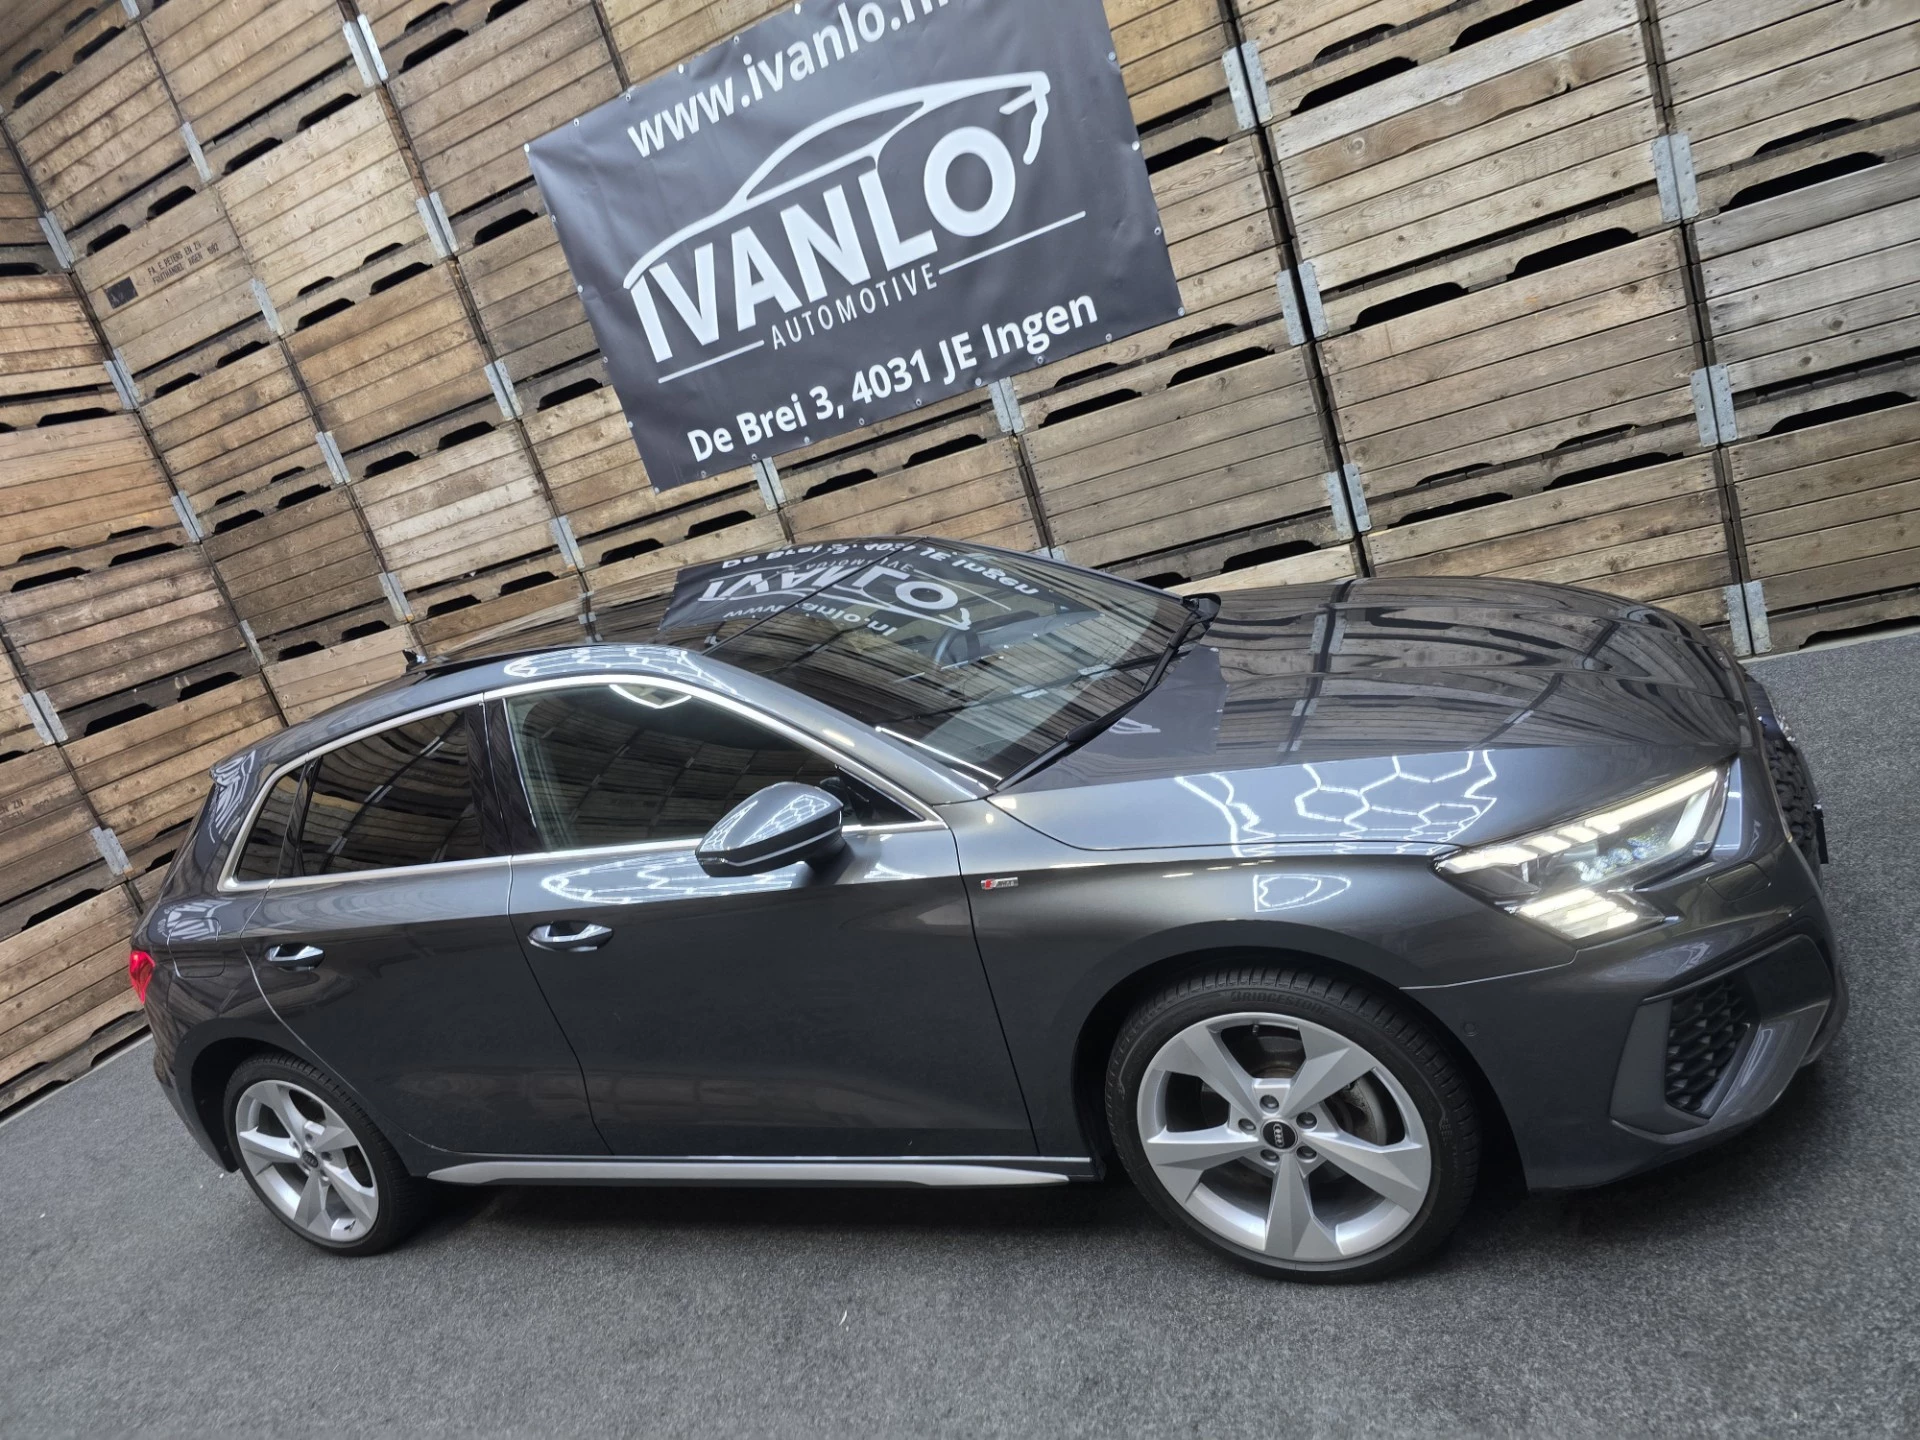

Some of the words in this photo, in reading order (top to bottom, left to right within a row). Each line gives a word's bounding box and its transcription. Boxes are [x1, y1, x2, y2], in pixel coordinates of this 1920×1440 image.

[630, 127, 1016, 363] IVANLO
[771, 262, 938, 350] AUTOMOTIVE
[687, 427, 734, 462] De
[736, 401, 808, 446] Brei
[809, 385, 844, 420] 3,
[851, 348, 931, 404] 4031
[938, 331, 978, 386] JE
[981, 295, 1098, 359] Ingen
[1230, 990, 1332, 1016] BRIDGESTONE
